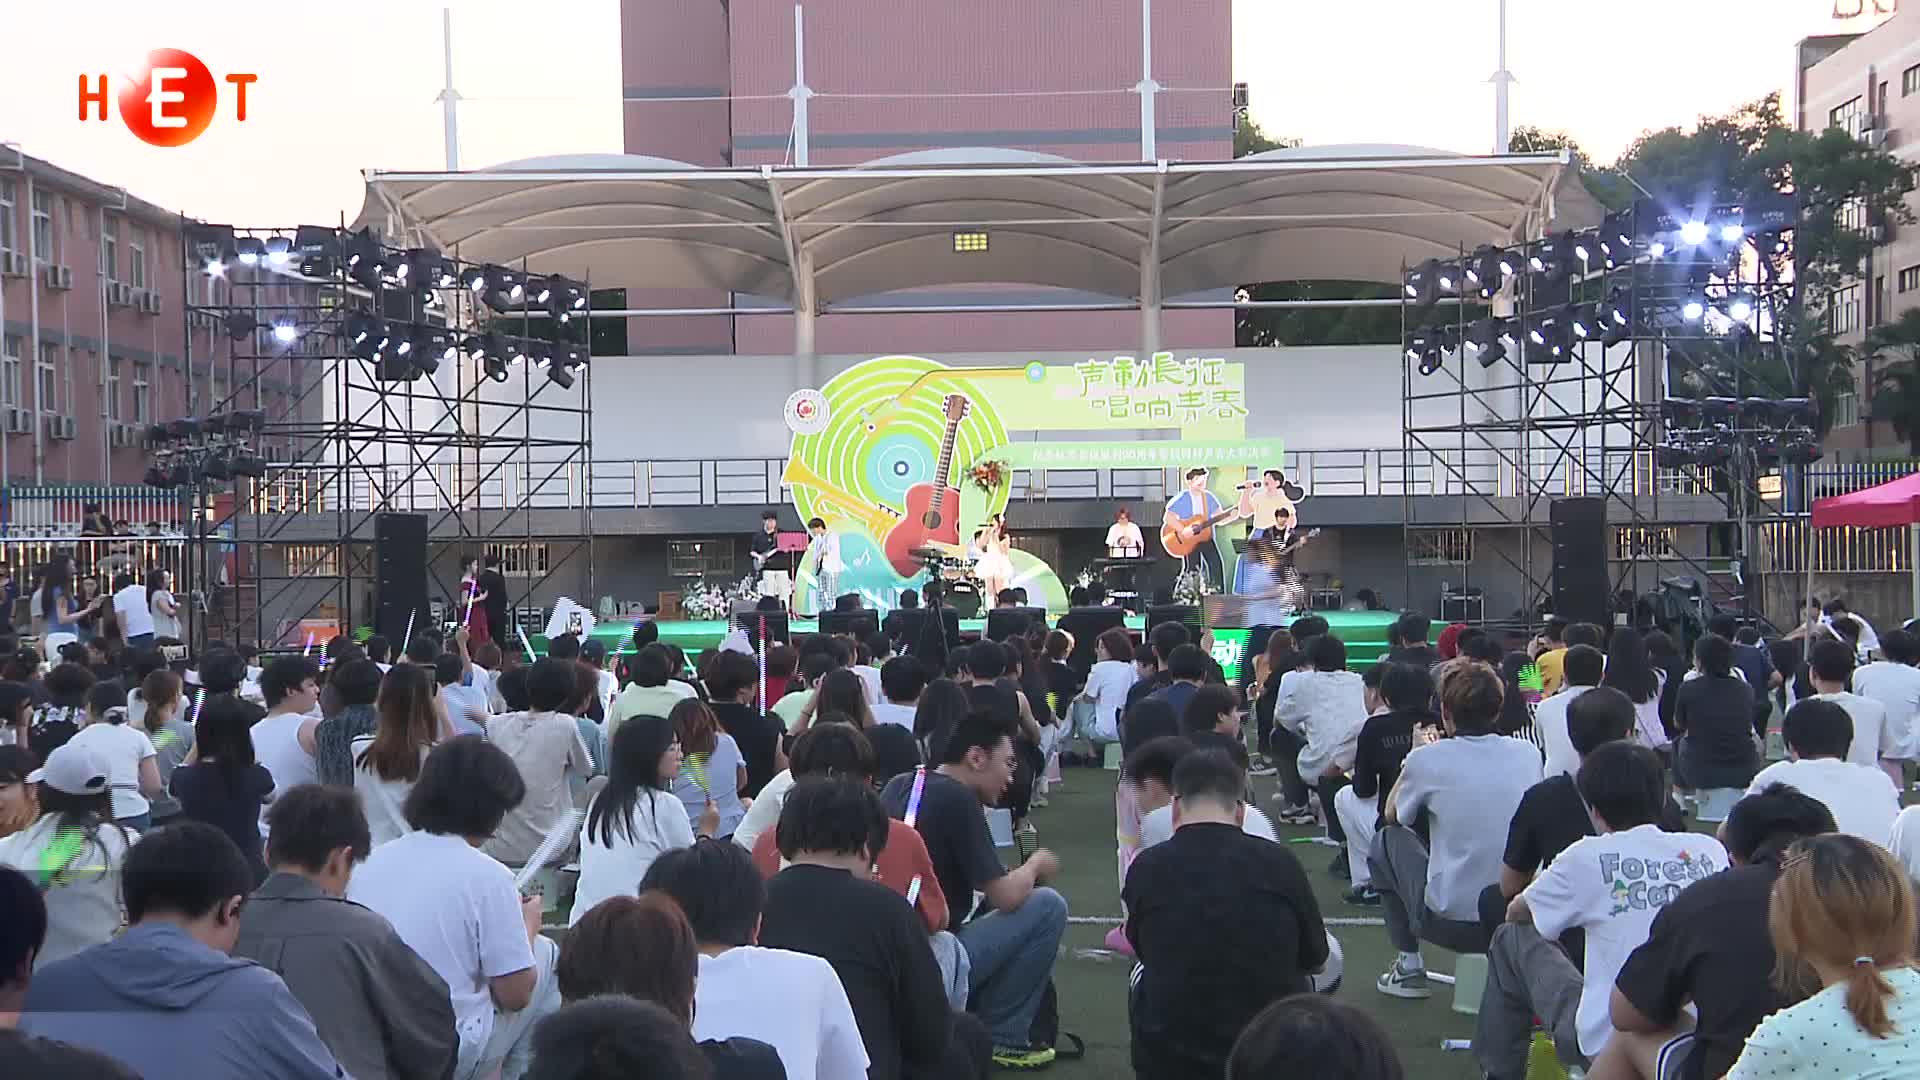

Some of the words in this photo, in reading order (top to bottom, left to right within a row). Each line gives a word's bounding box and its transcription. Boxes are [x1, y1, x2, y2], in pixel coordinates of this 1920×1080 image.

[1091, 391, 1247, 421] 唱响青春
[1599, 852, 1714, 884] Forest
